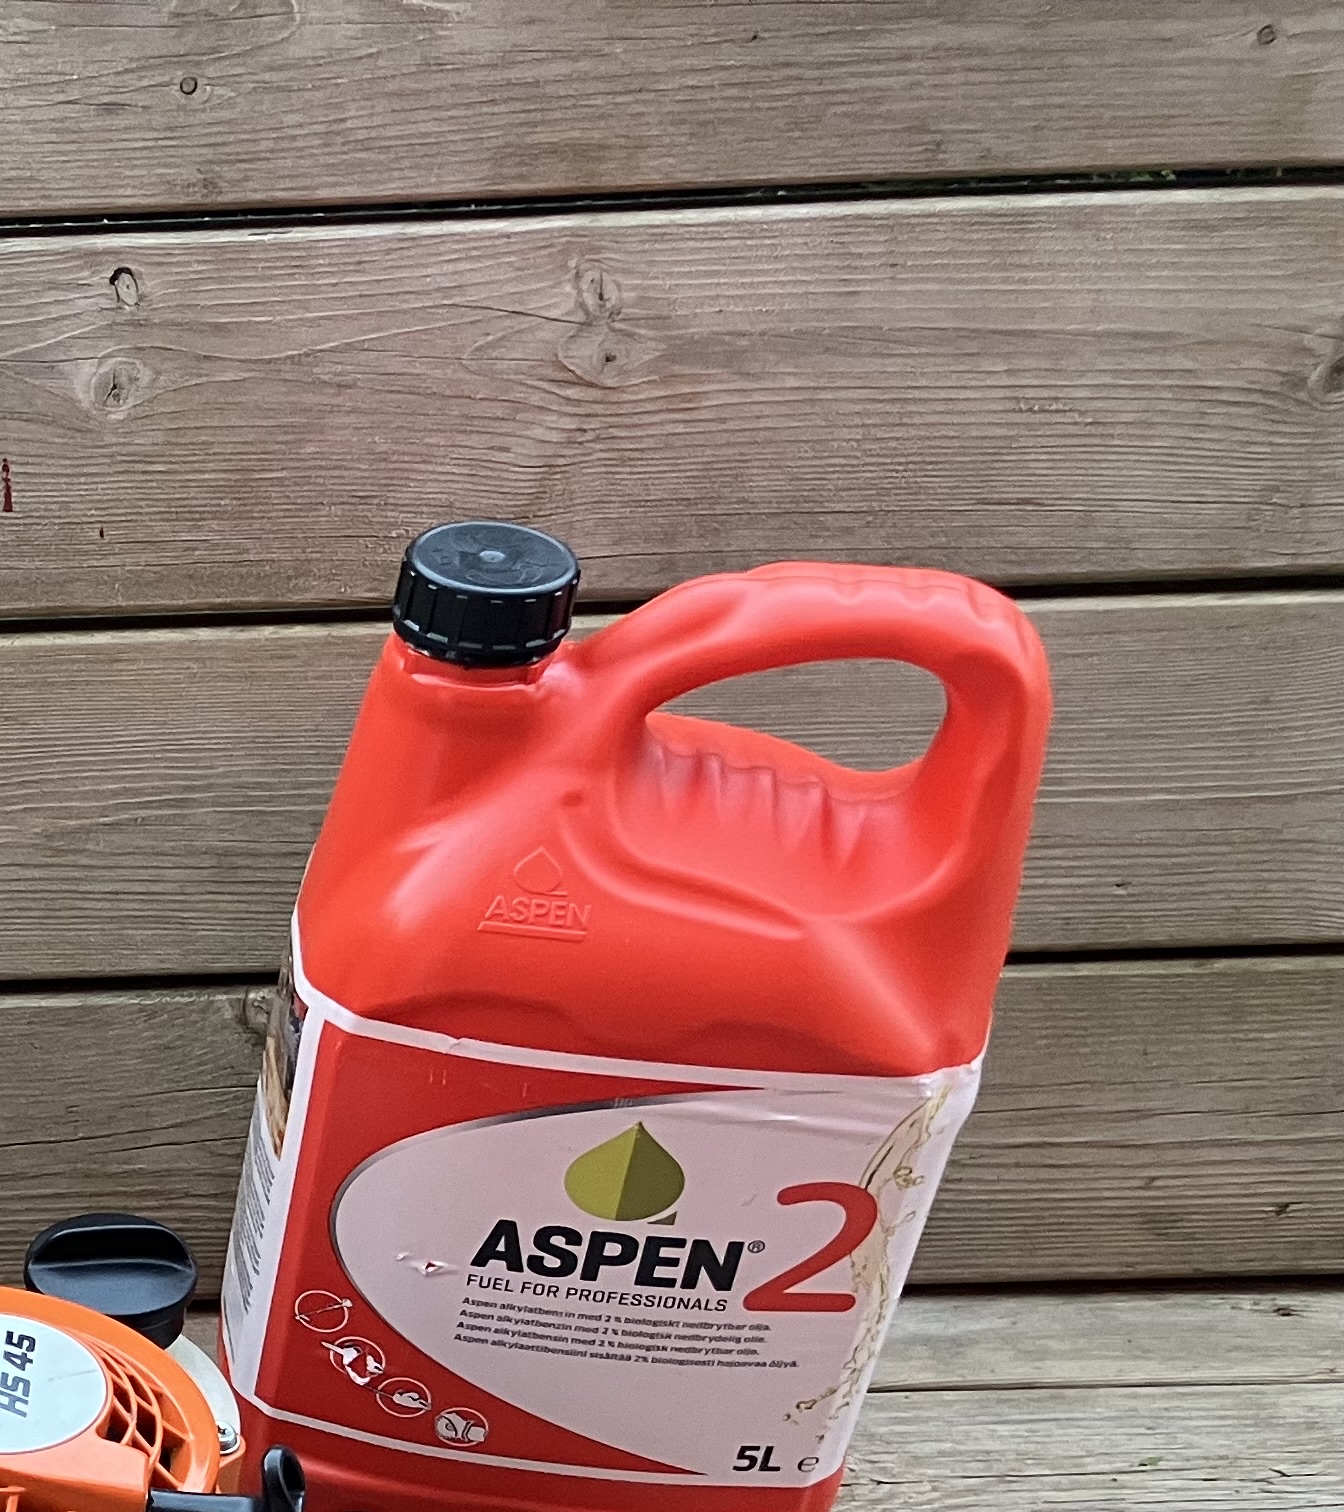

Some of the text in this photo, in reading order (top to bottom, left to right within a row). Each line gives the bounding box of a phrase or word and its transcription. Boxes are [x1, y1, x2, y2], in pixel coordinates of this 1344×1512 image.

[484, 895, 591, 927] ASPEN
[743, 1182, 877, 1312] 2
[466, 1273, 728, 1312] FUEL FOR PROFESSIONALS
[459, 1309, 494, 1321] Aspen
[574, 1324, 599, 1334] med
[462, 1297, 498, 1309] Aspen
[577, 1312, 602, 1322] med
[454, 1333, 489, 1345] Aspen
[456, 1321, 491, 1333] Aspen
[571, 1336, 596, 1346] med
[3, 1330, 36, 1371] 45
[732, 1445, 781, 1472] 5L
